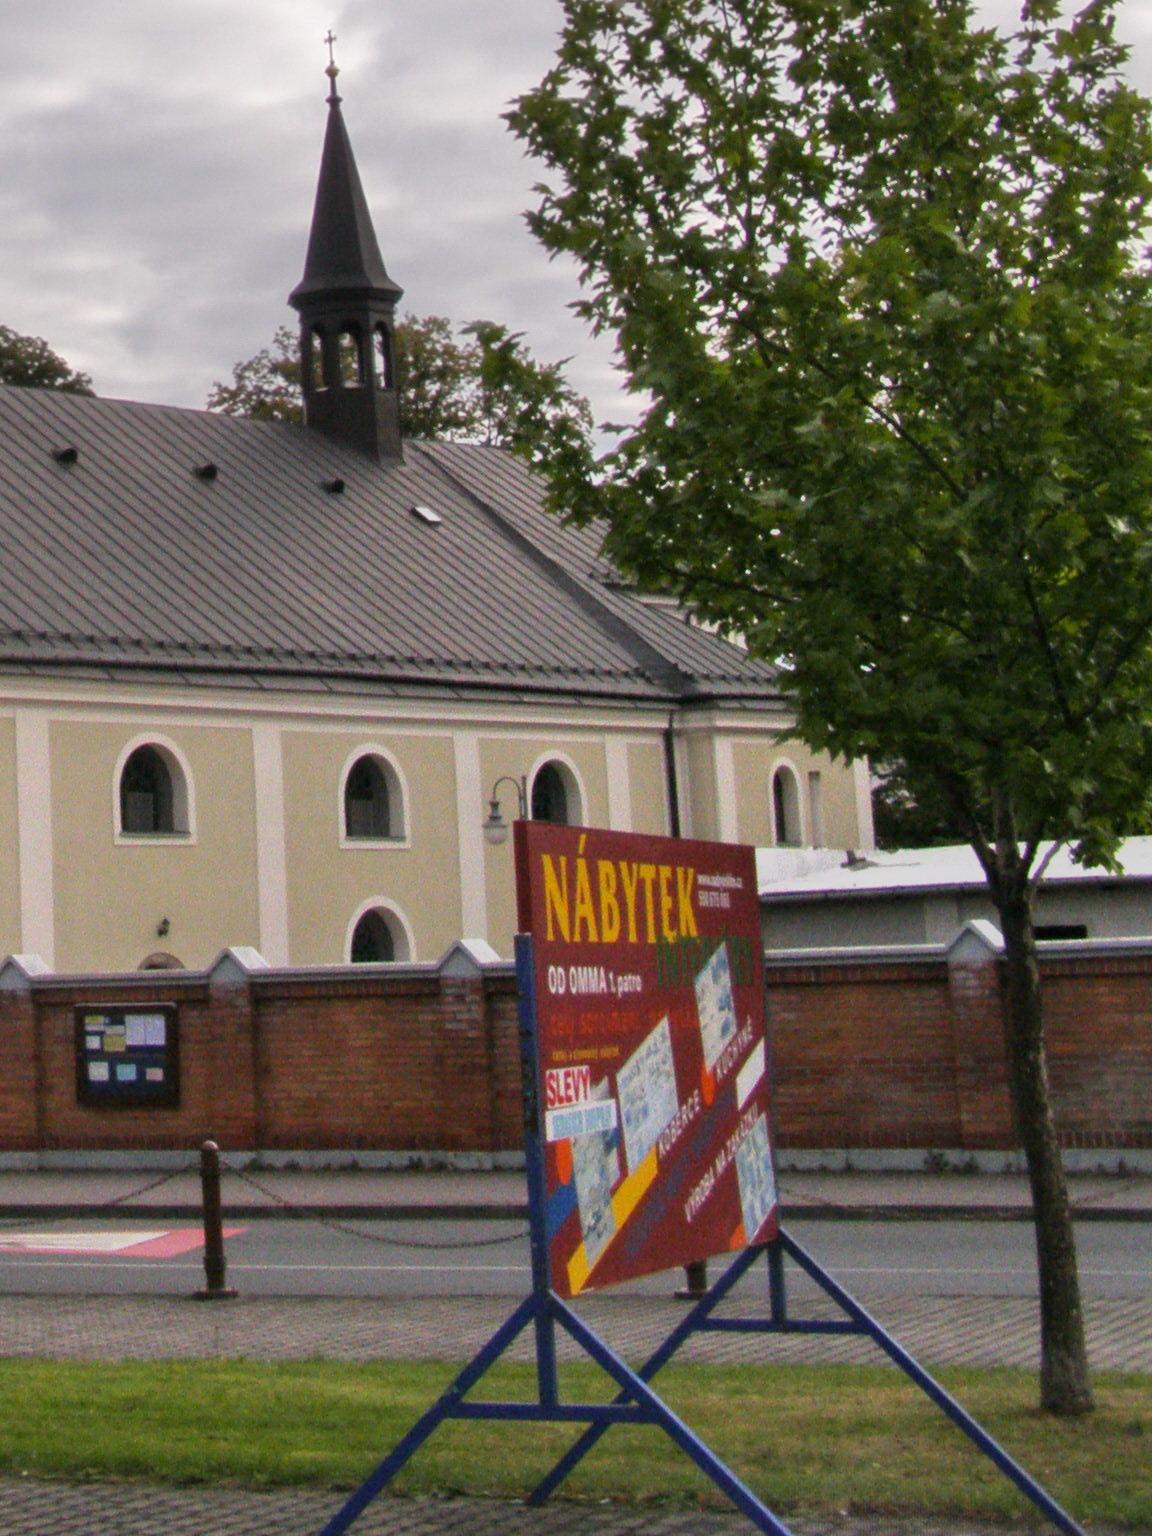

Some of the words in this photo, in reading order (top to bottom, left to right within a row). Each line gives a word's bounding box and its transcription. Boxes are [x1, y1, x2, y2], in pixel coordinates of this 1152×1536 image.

[541, 834, 699, 943] NÁBYTEK
[548, 964, 566, 995] OD
[568, 966, 607, 996] OMMA
[617, 974, 642, 999] patro
[546, 1067, 591, 1107] SLEVY
[657, 1088, 702, 1160] KOBERCE
